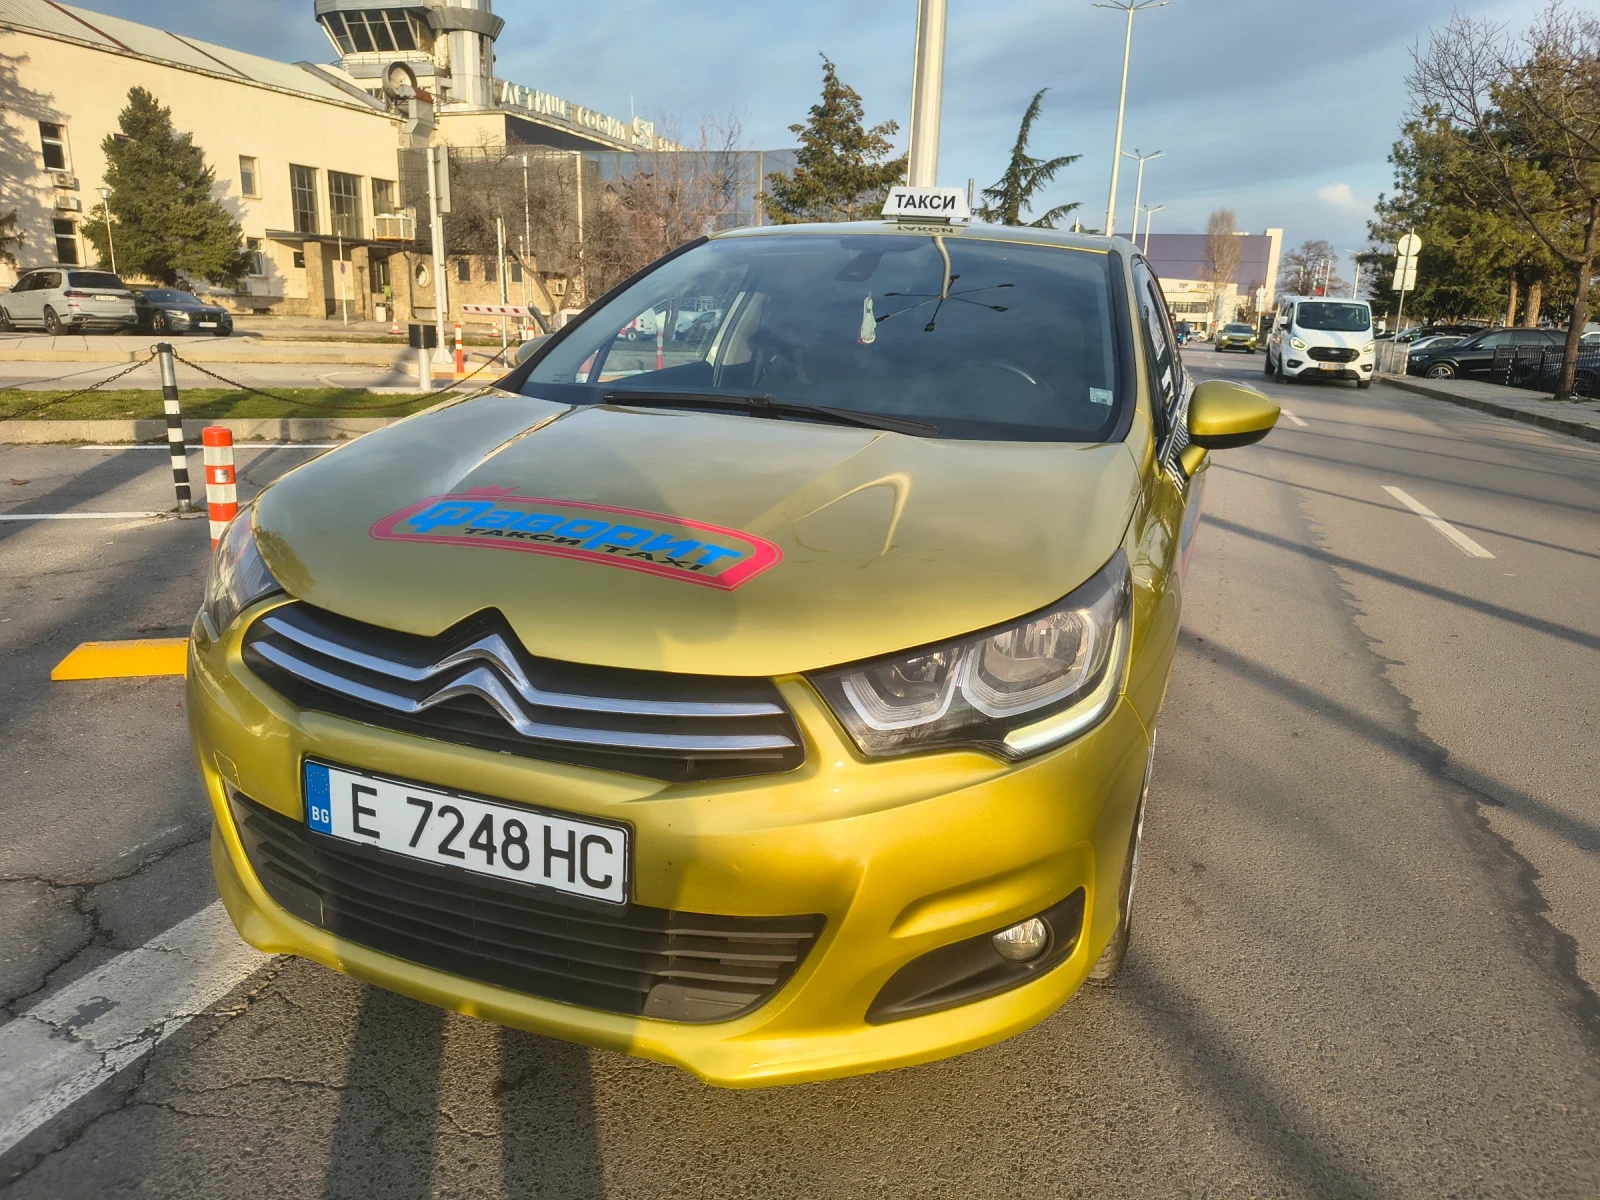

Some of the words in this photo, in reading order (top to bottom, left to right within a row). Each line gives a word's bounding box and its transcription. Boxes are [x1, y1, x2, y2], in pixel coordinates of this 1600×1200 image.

[895, 194, 956, 210] ТАКСИ
[464, 527, 581, 546] ТАКСИ
[603, 544, 704, 572] TAXI
[311, 805, 329, 824] BG
[351, 782, 380, 839] E
[406, 796, 530, 871] 7248
[543, 825, 613, 890] HC
